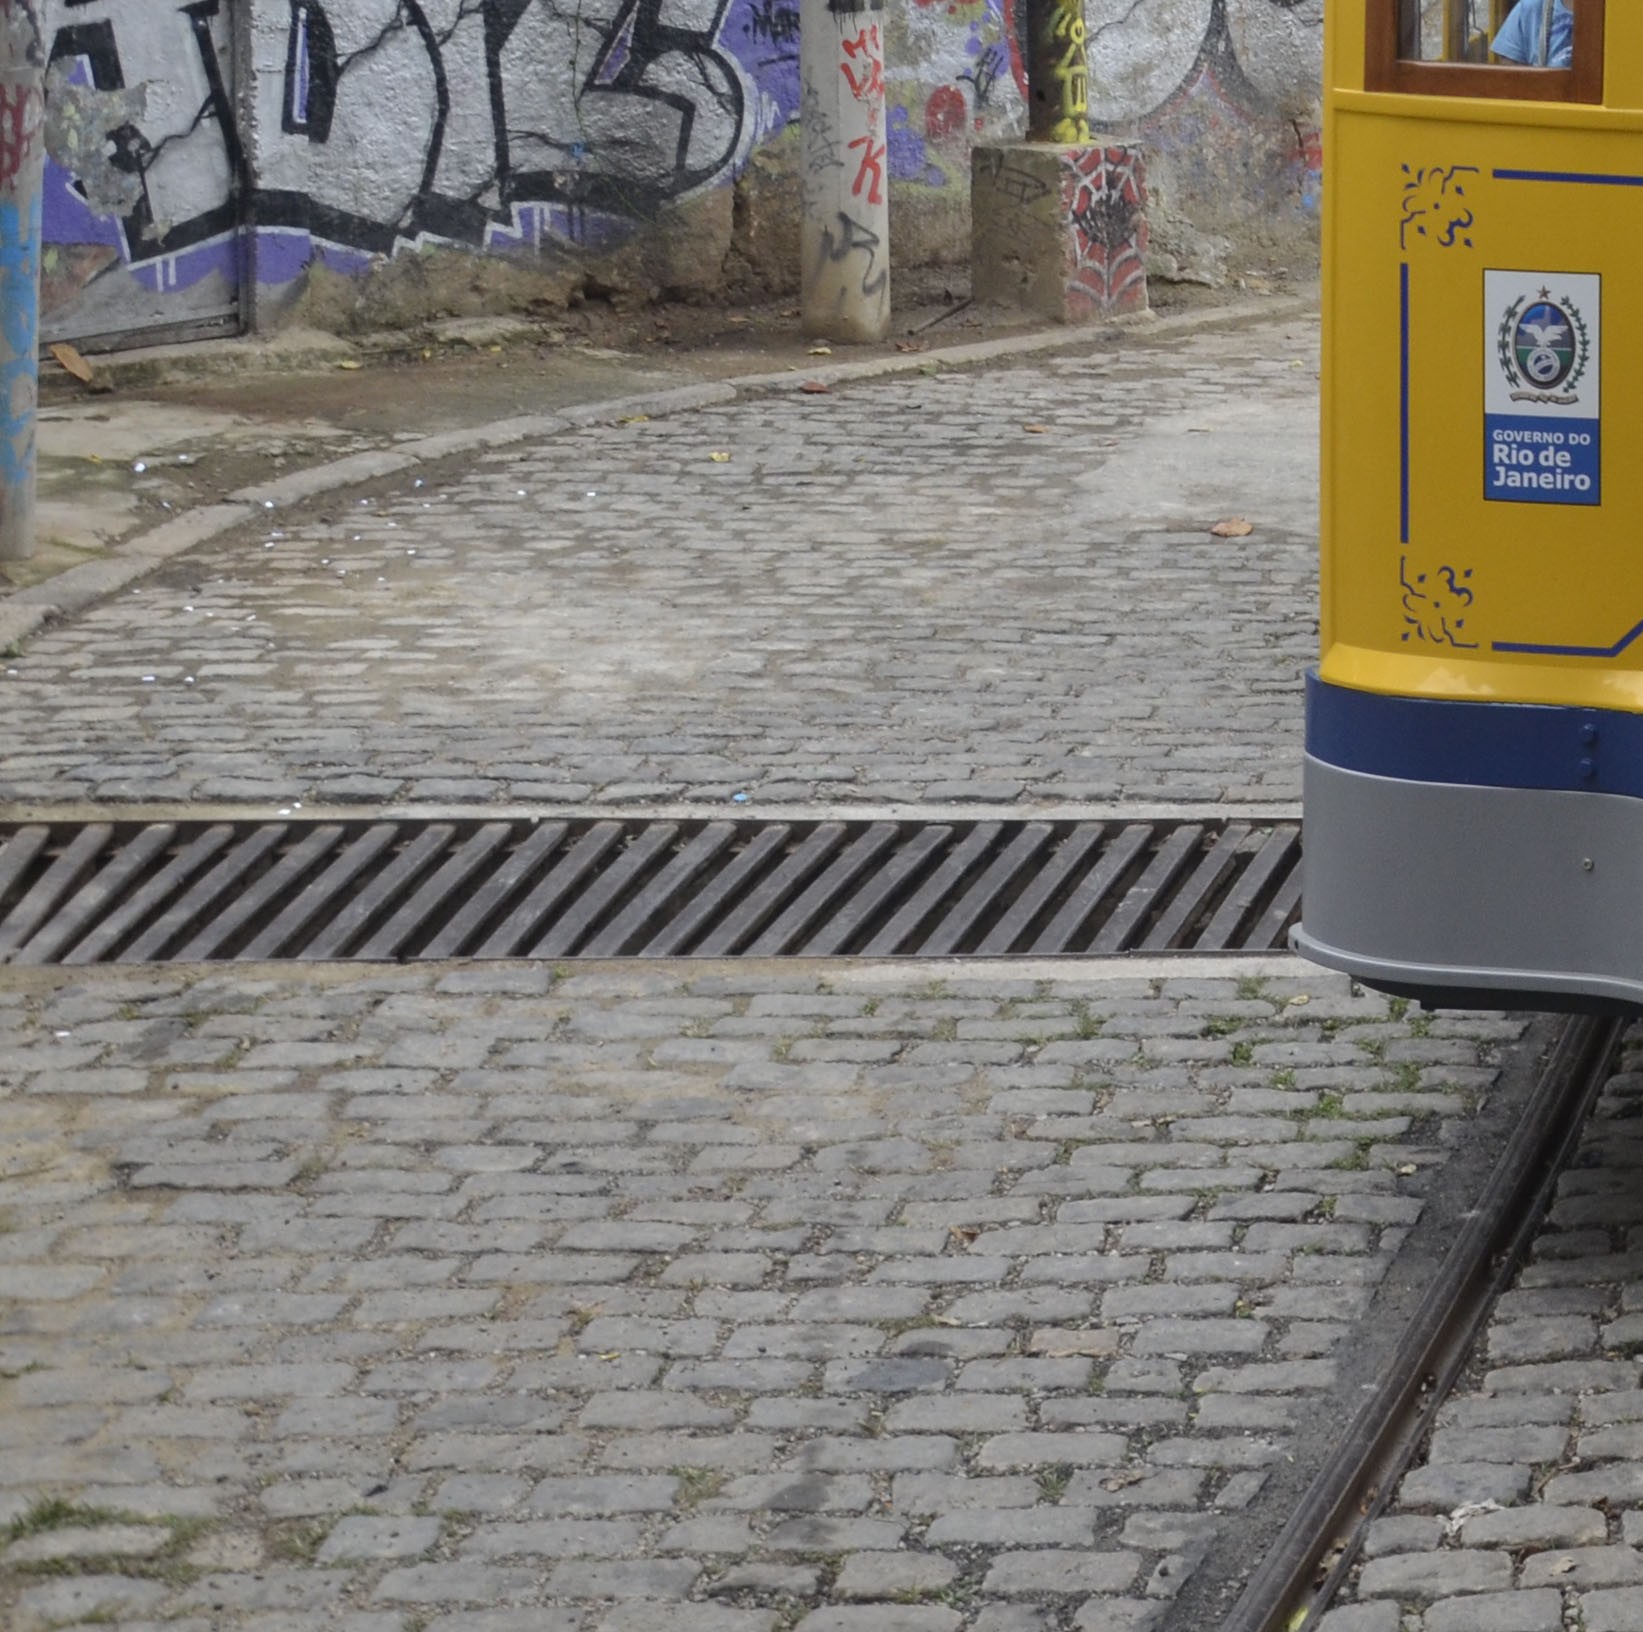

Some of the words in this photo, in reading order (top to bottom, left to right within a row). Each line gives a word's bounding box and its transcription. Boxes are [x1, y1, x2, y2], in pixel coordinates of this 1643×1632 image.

[1493, 429, 1565, 445] GOVERNO
[1568, 432, 1591, 446] DO
[1493, 443, 1534, 466] Rio
[1538, 445, 1572, 467] de
[1492, 466, 1592, 491] Janeiro
